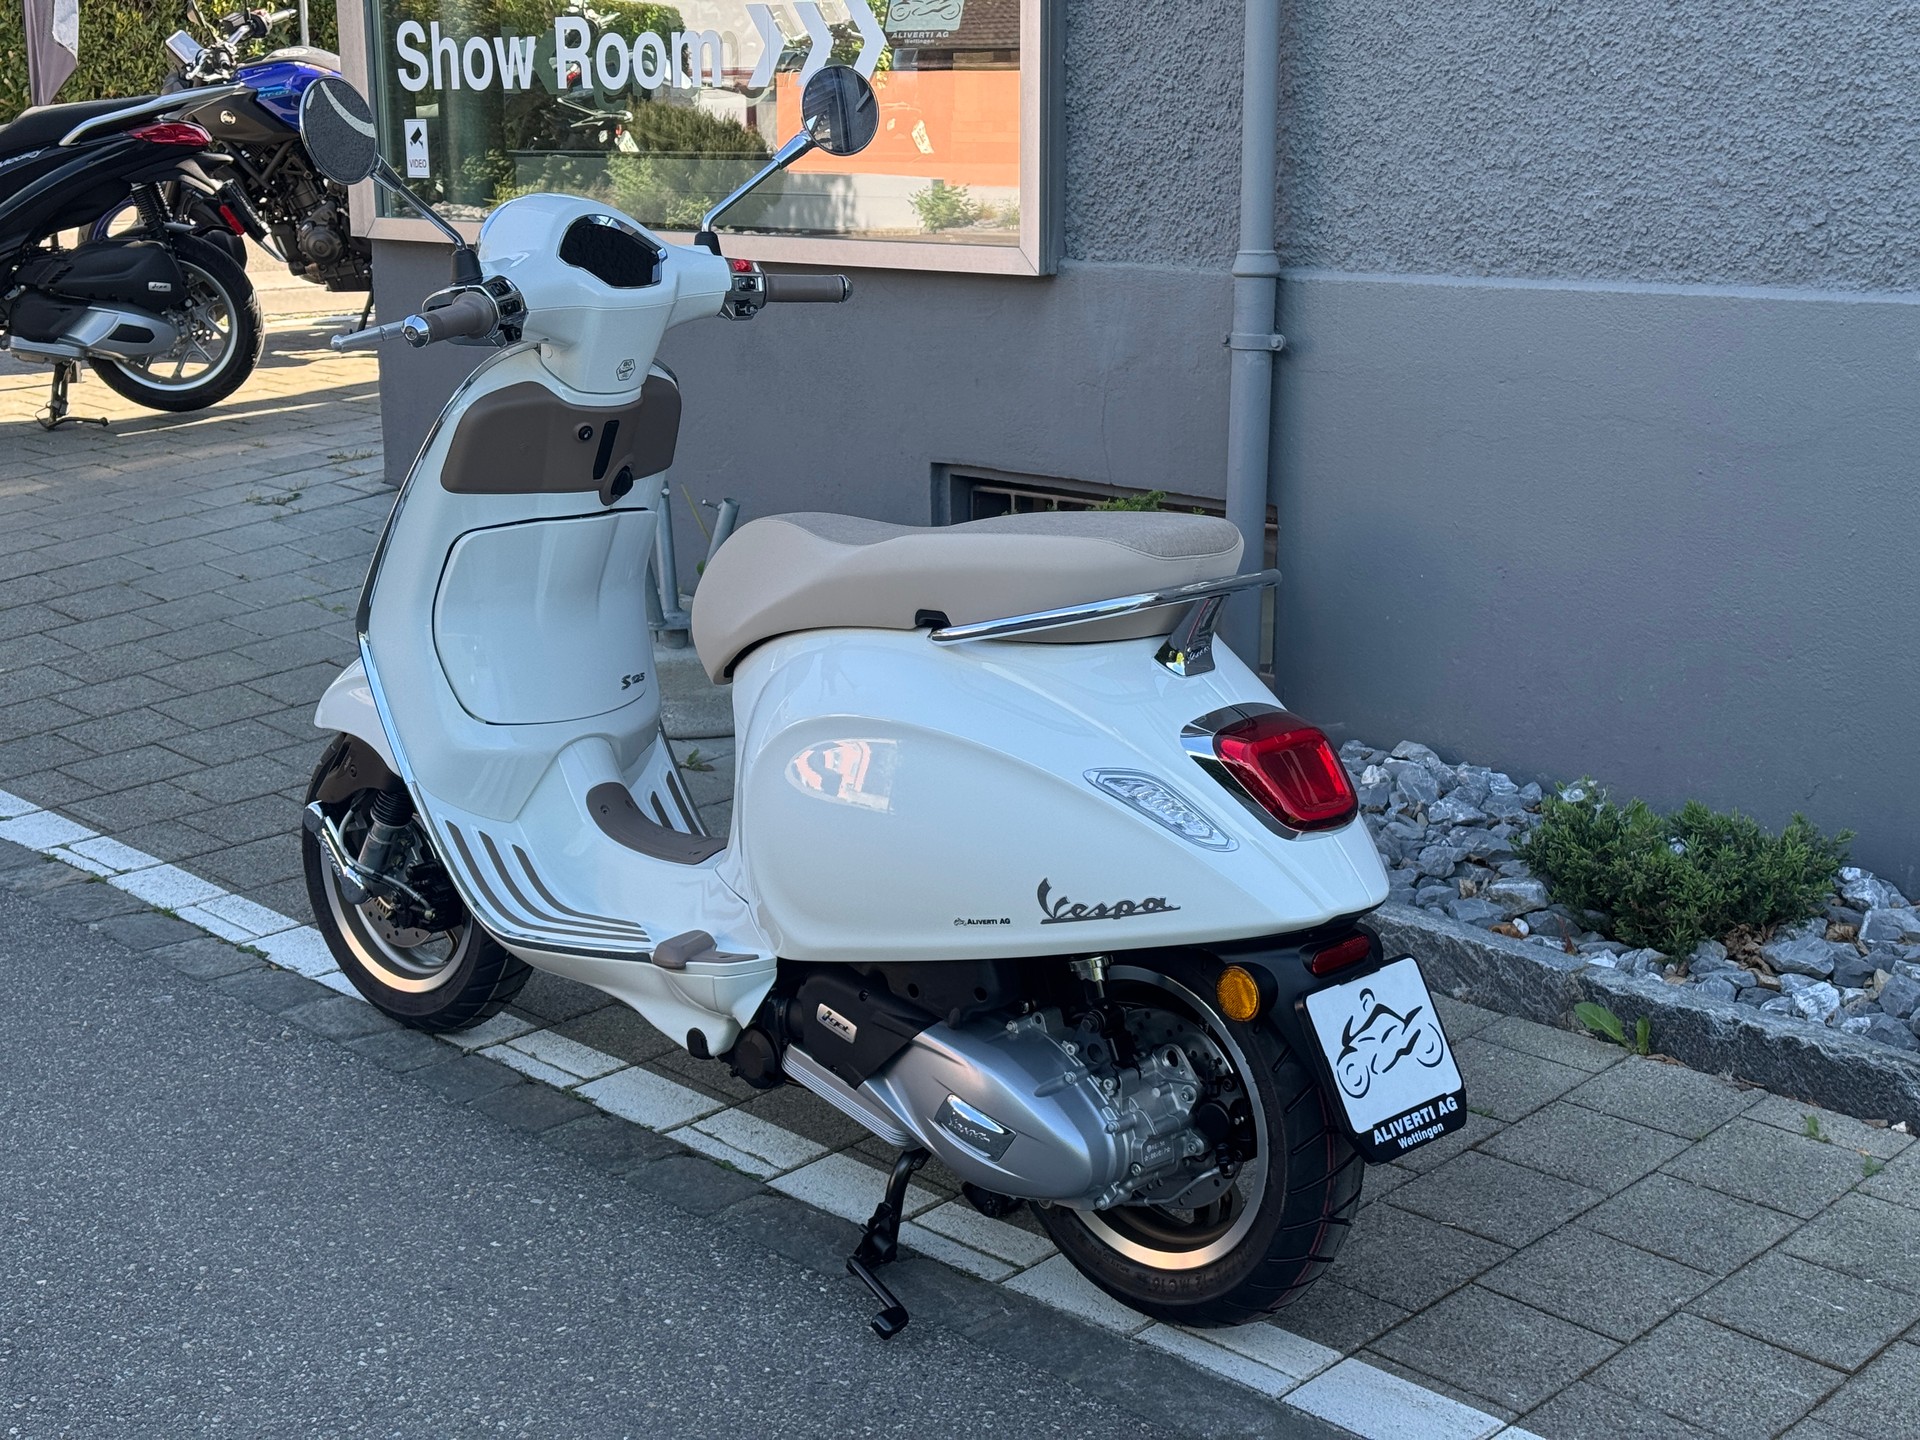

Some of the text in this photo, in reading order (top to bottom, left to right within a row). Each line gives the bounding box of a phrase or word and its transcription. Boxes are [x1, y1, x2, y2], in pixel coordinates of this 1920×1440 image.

[891, 31, 934, 39] ALIVERTI
[396, 20, 536, 92] Show
[554, 16, 724, 91] Room
[409, 158, 427, 168] VIDEO
[1037, 877, 1181, 924] Vespa
[999, 917, 1011, 925] AG
[1373, 1096, 1458, 1145] ALIVERTI AG
[1397, 1122, 1445, 1149] Wettingen
